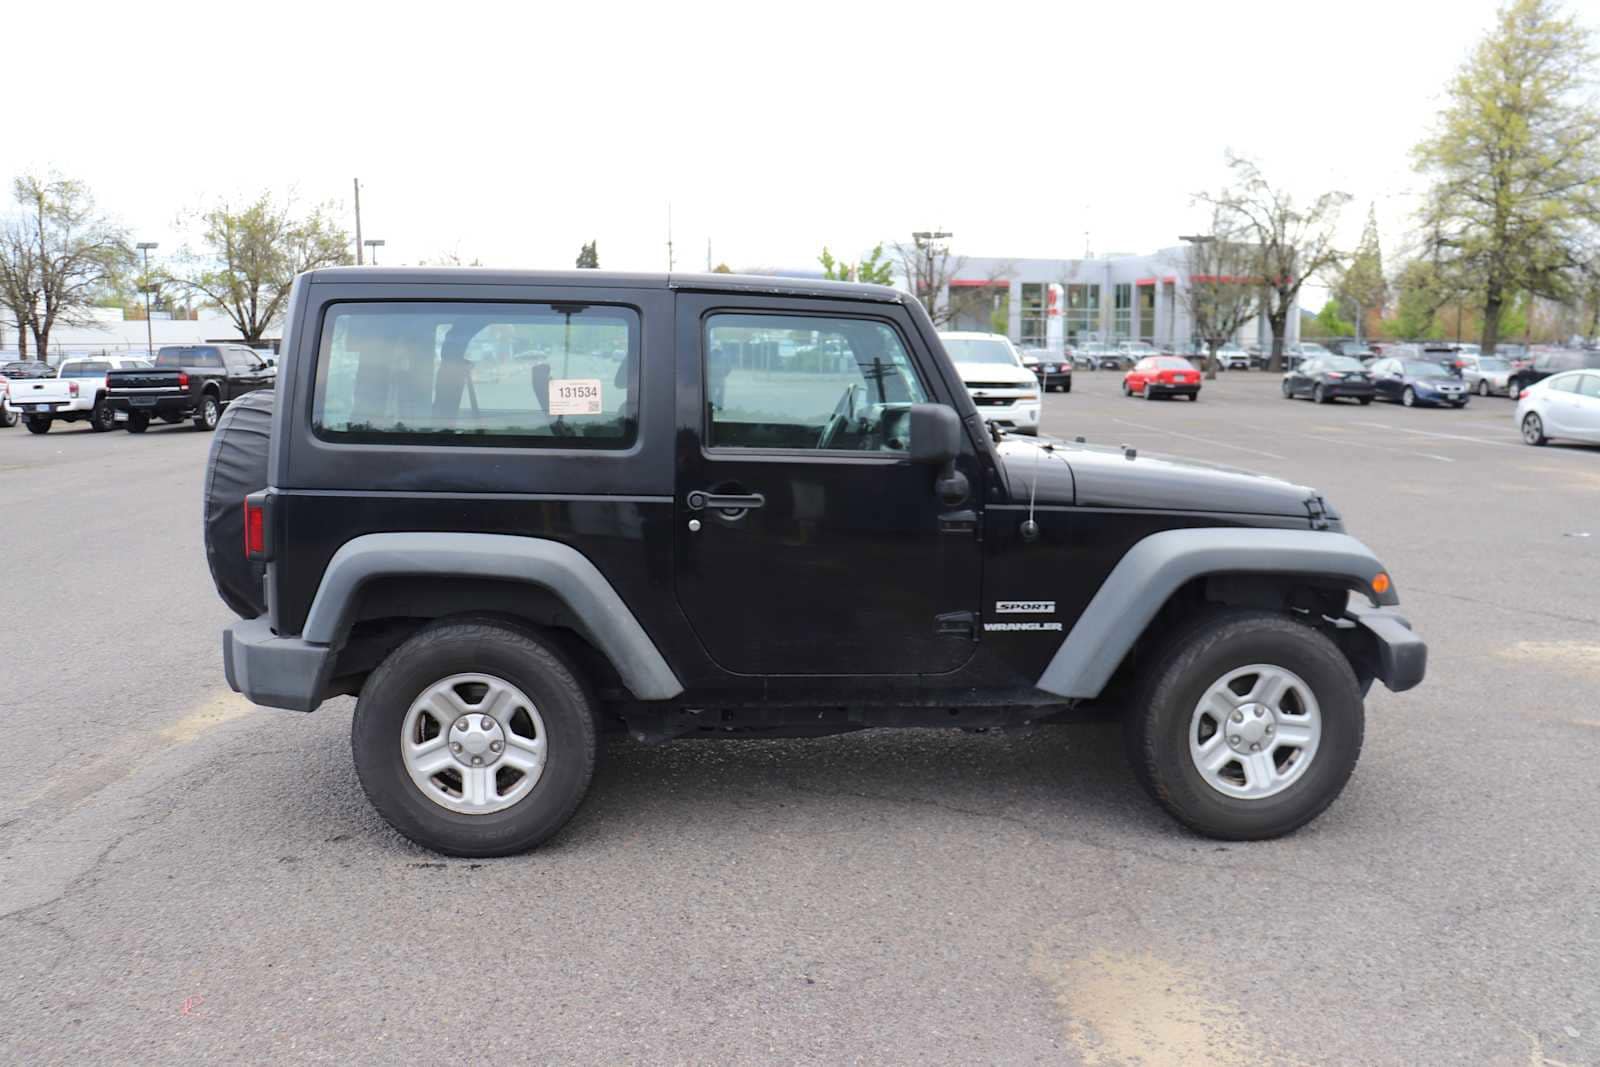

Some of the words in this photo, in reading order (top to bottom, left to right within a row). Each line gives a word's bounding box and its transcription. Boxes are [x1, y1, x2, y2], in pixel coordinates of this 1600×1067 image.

[559, 386, 597, 398] 131534
[997, 602, 1055, 611] SPORT
[983, 622, 1062, 631] WRANGLER
